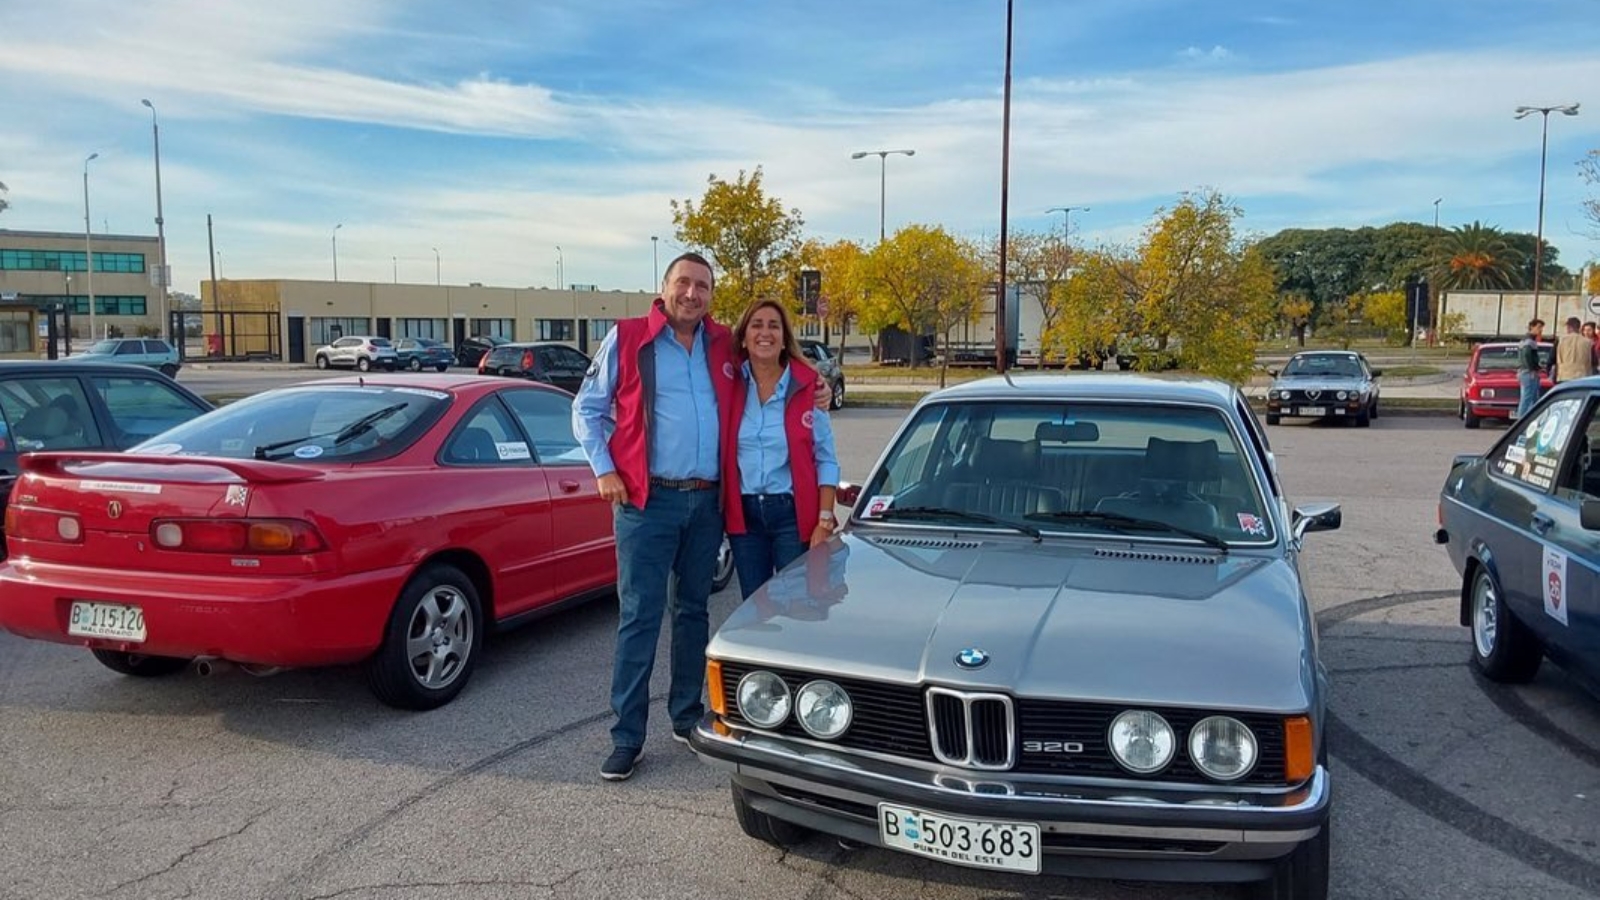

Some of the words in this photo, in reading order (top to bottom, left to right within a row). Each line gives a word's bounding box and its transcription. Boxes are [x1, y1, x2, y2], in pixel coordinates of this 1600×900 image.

[72, 605, 81, 624] B
[80, 626, 133, 637] MALDONADO
[1023, 741, 1083, 753] 320
[885, 811, 900, 836] B
[913, 842, 949, 857] PUNTA
[951, 852, 972, 862] DEL
[974, 854, 1004, 866] ESTE
